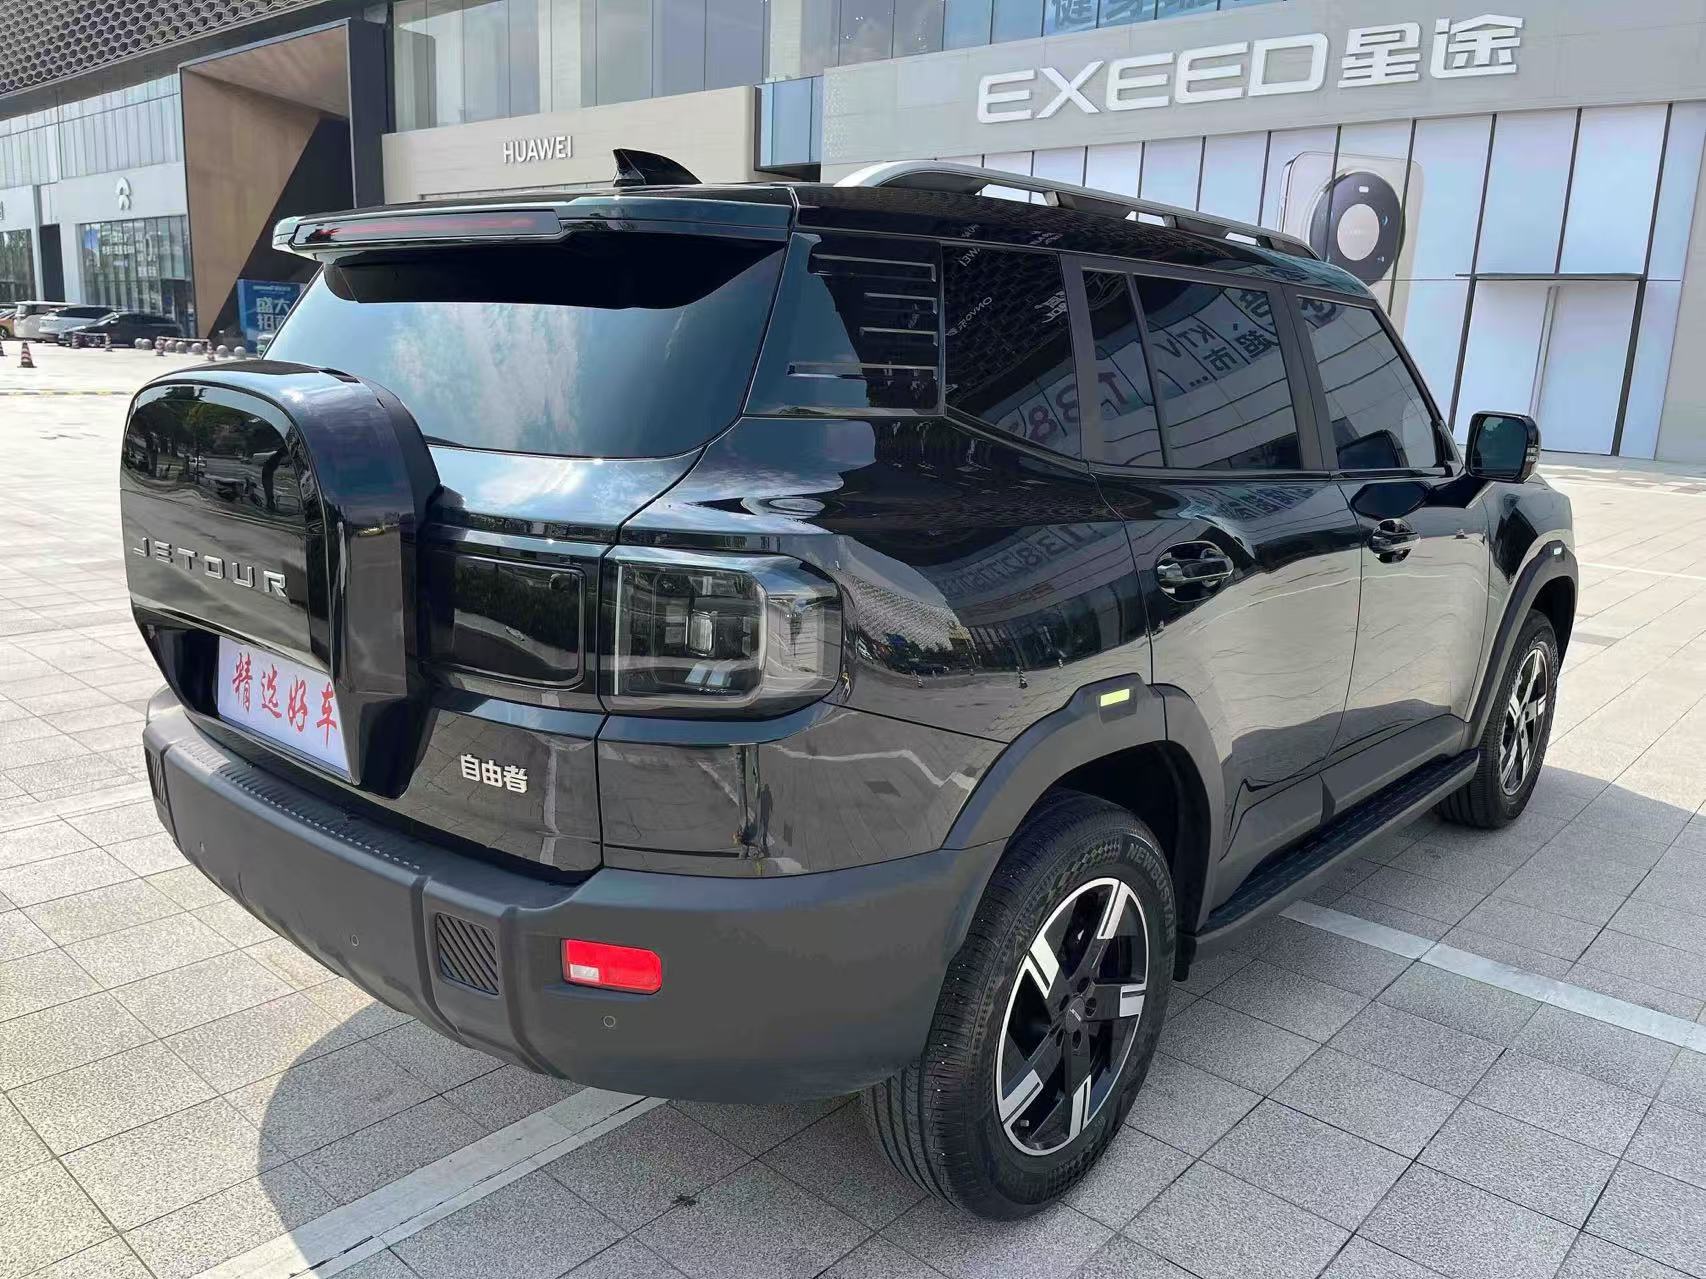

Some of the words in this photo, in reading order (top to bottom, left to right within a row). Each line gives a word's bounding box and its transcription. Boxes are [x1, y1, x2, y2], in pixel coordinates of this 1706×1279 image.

[978, 32, 1328, 124] EXEED
[1337, 14, 1523, 89] 星途
[503, 136, 573, 163] HUAWEI
[133, 537, 287, 597] JETOUR
[231, 652, 338, 748] 精选好车
[460, 753, 528, 793] 自由者
